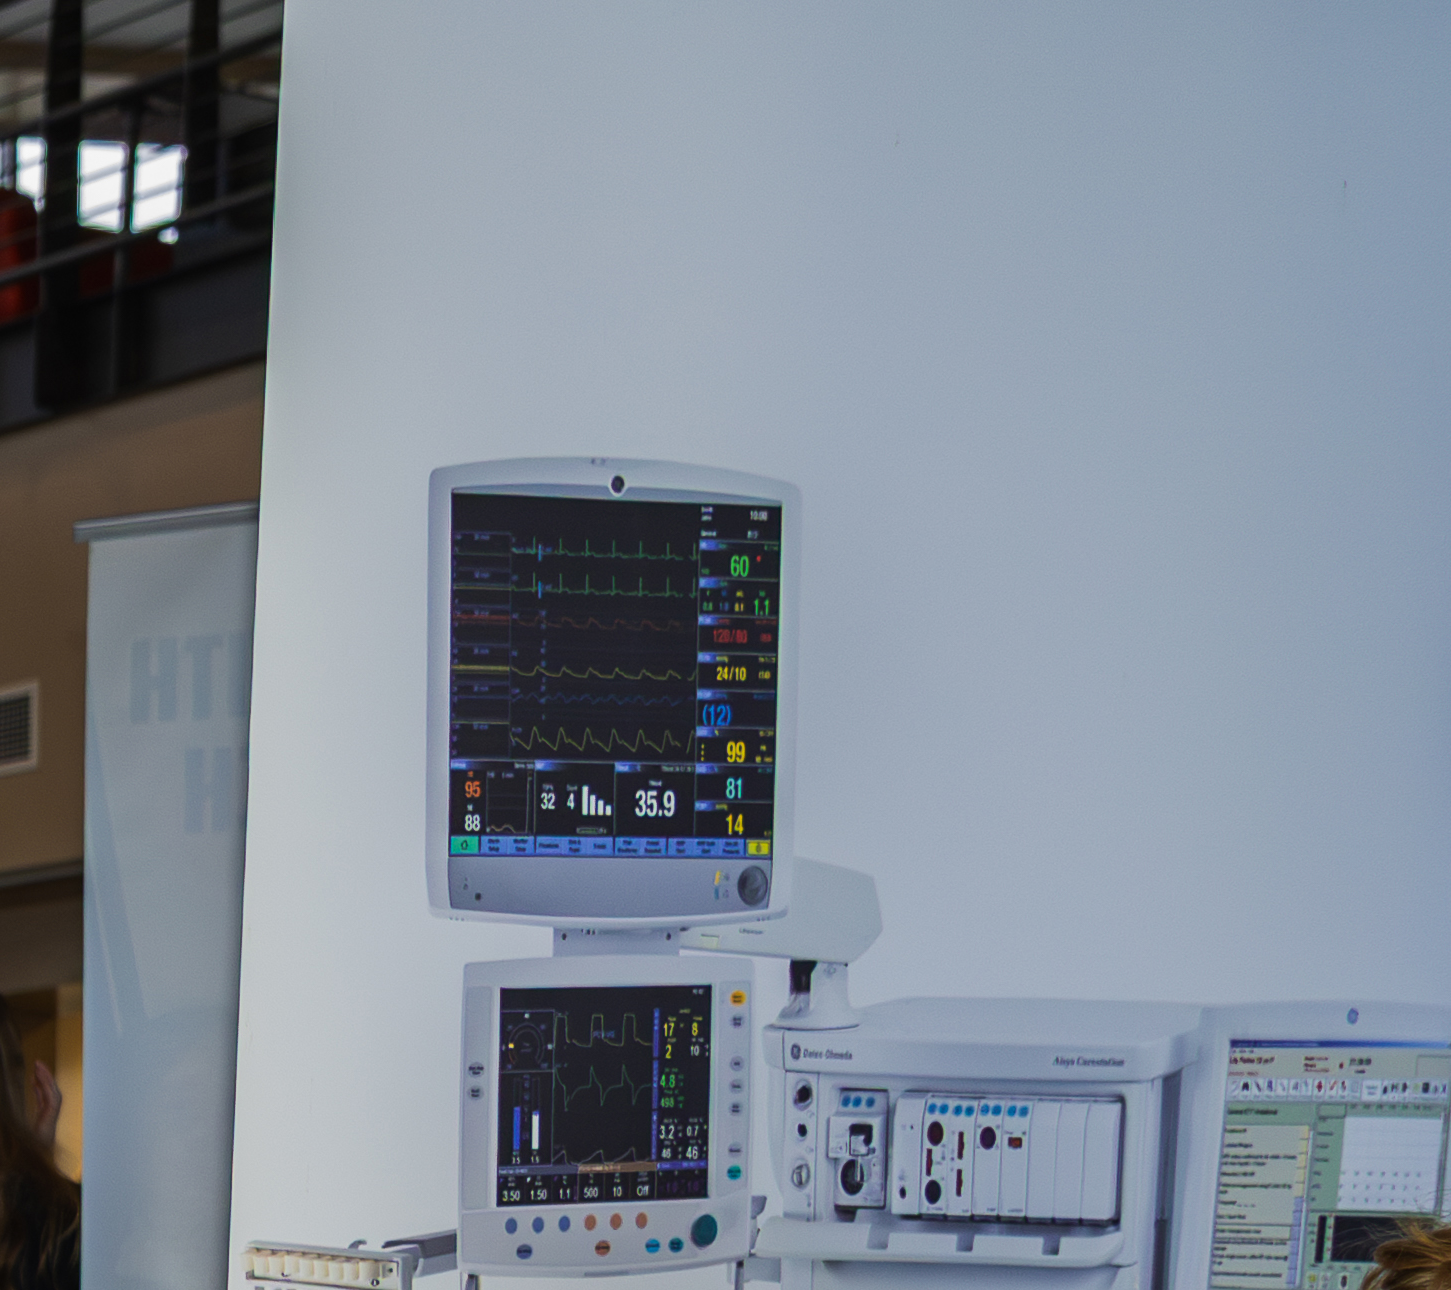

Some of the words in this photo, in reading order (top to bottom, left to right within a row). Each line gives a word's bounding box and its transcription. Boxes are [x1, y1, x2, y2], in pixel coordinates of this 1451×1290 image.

[730, 555, 749, 577] 60
[754, 599, 769, 616] 1.1
[716, 666, 746, 681] 24/10
[702, 704, 732, 726] (12)
[726, 741, 746, 763] 99
[465, 781, 481, 798] 95
[726, 777, 742, 799] 81
[540, 793, 556, 810] 32
[566, 793, 575, 810] 4
[635, 790, 676, 817] 35.9
[465, 814, 481, 832] 88
[726, 814, 744, 835] 14
[663, 1022, 675, 1037] 17
[691, 1022, 699, 1036] 8
[665, 1044, 672, 1059] 2
[690, 1045, 700, 1057] 10
[659, 1074, 676, 1089] 4.8
[659, 1125, 675, 1140] 3.2
[686, 1125, 699, 1138] 0.7
[502, 1190, 521, 1202] 3.50
[530, 1189, 548, 1201] 1.50
[583, 1187, 599, 1199] 500
[612, 1186, 623, 1198] 10
[636, 1185, 649, 1197] Off
